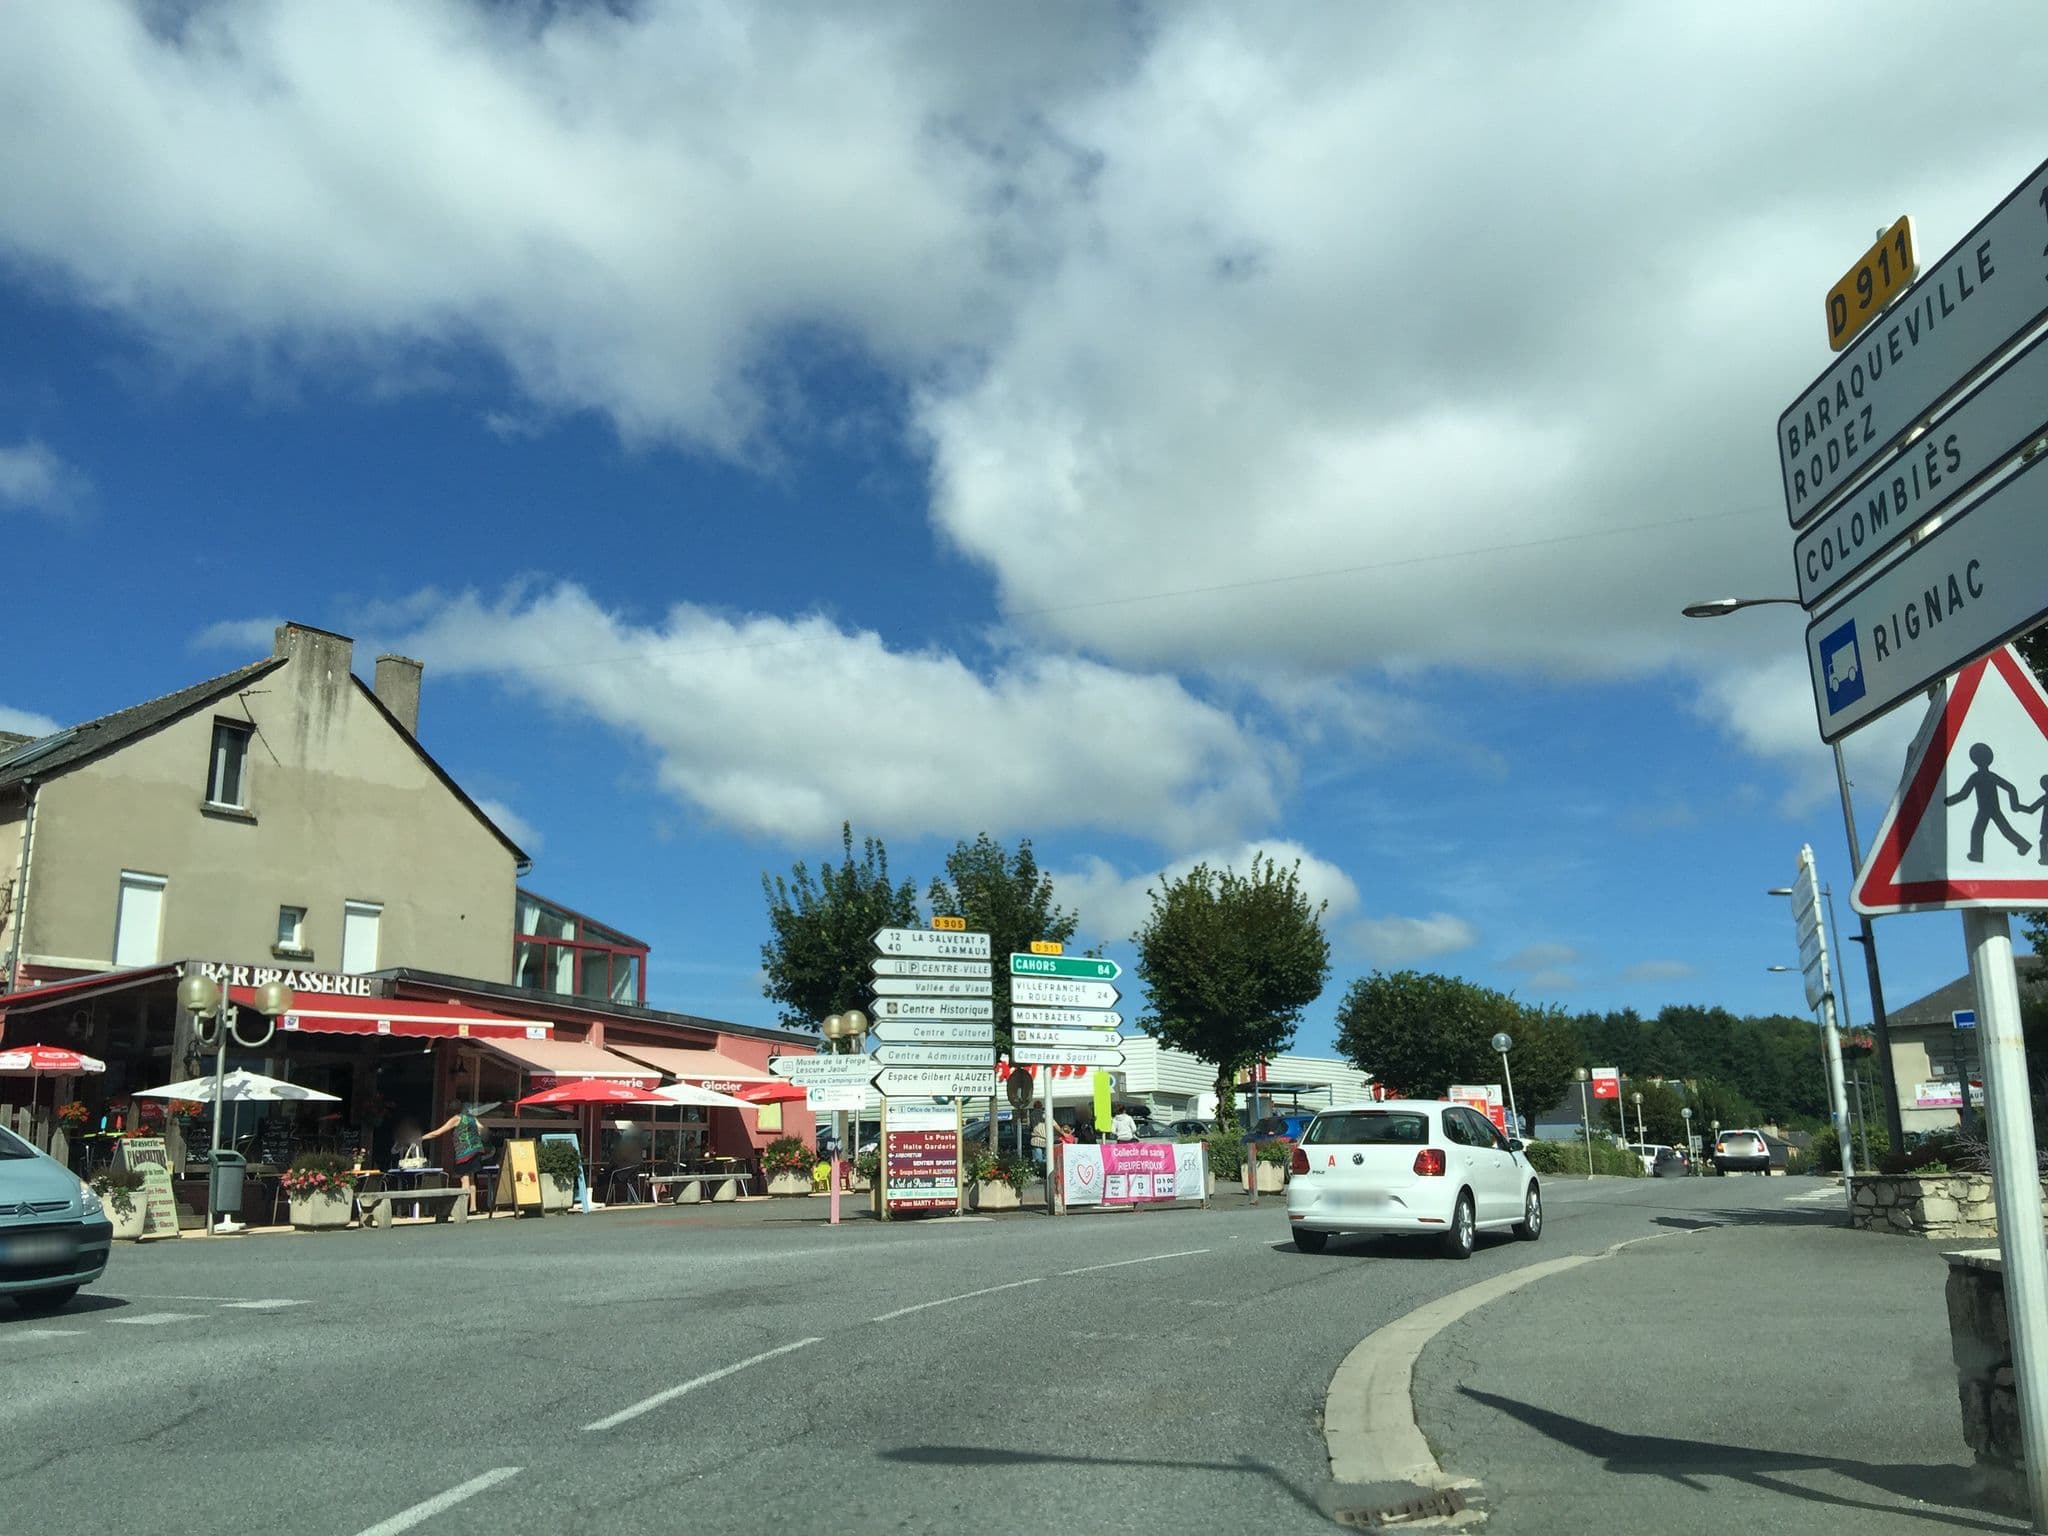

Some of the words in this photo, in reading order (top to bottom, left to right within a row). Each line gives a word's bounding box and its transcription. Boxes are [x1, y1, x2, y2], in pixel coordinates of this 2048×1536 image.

[1831, 296, 1847, 338] D
[1857, 229, 1911, 310] 911
[1788, 239, 1995, 460] BARAQUEVILLE
[1793, 404, 1877, 505] RODEZ
[1806, 432, 1962, 584] COLOMBIÈS
[1872, 558, 1985, 664] RIGNAC
[934, 918, 941, 928] D
[944, 918, 964, 929] 905
[890, 932, 901, 942] 12
[912, 933, 924, 943] LA
[929, 934, 976, 945] SALVETAT
[888, 943, 901, 952] 40
[938, 946, 988, 956] CARMAUX
[1035, 943, 1041, 952] D
[1043, 944, 1060, 953] 911
[1015, 958, 1057, 972] CAHORS
[1097, 964, 1111, 976] 84
[915, 982, 944, 992] Vallée
[949, 983, 960, 992] du
[965, 983, 990, 993] Viaur
[1016, 982, 1087, 993] VILLEFRANCHE
[1097, 992, 1108, 1000] 24
[902, 1004, 935, 1014] Centre
[940, 1004, 990, 1017] Historique
[1016, 1012, 1082, 1022] MONTBAZENS
[1104, 1015, 1116, 1024] 25
[914, 1028, 945, 1037] Centre
[951, 1028, 991, 1038] Culturel
[1029, 1032, 1060, 1041] NAJAC
[796, 1058, 821, 1067] Musée
[823, 1058, 833, 1066] de
[835, 1057, 843, 1066] la
[845, 1057, 866, 1067] Forge
[888, 1051, 920, 1061] Centre
[928, 1052, 992, 1062] Administratif
[1017, 1050, 1060, 1062] Complexe
[1067, 1052, 1097, 1063] Sportif
[796, 1066, 825, 1075] Lescure
[888, 1072, 919, 1083] Espace
[921, 1072, 951, 1082] Gilbert
[954, 1072, 993, 1082] ALAUZET
[701, 1080, 742, 1092] Glacier
[952, 1084, 993, 1095] Gymnase
[924, 1133, 934, 1141] La
[935, 1133, 956, 1141] Poste
[903, 1143, 922, 1151] Halte
[924, 1143, 956, 1151] Garderie
[1328, 1155, 1336, 1167] A
